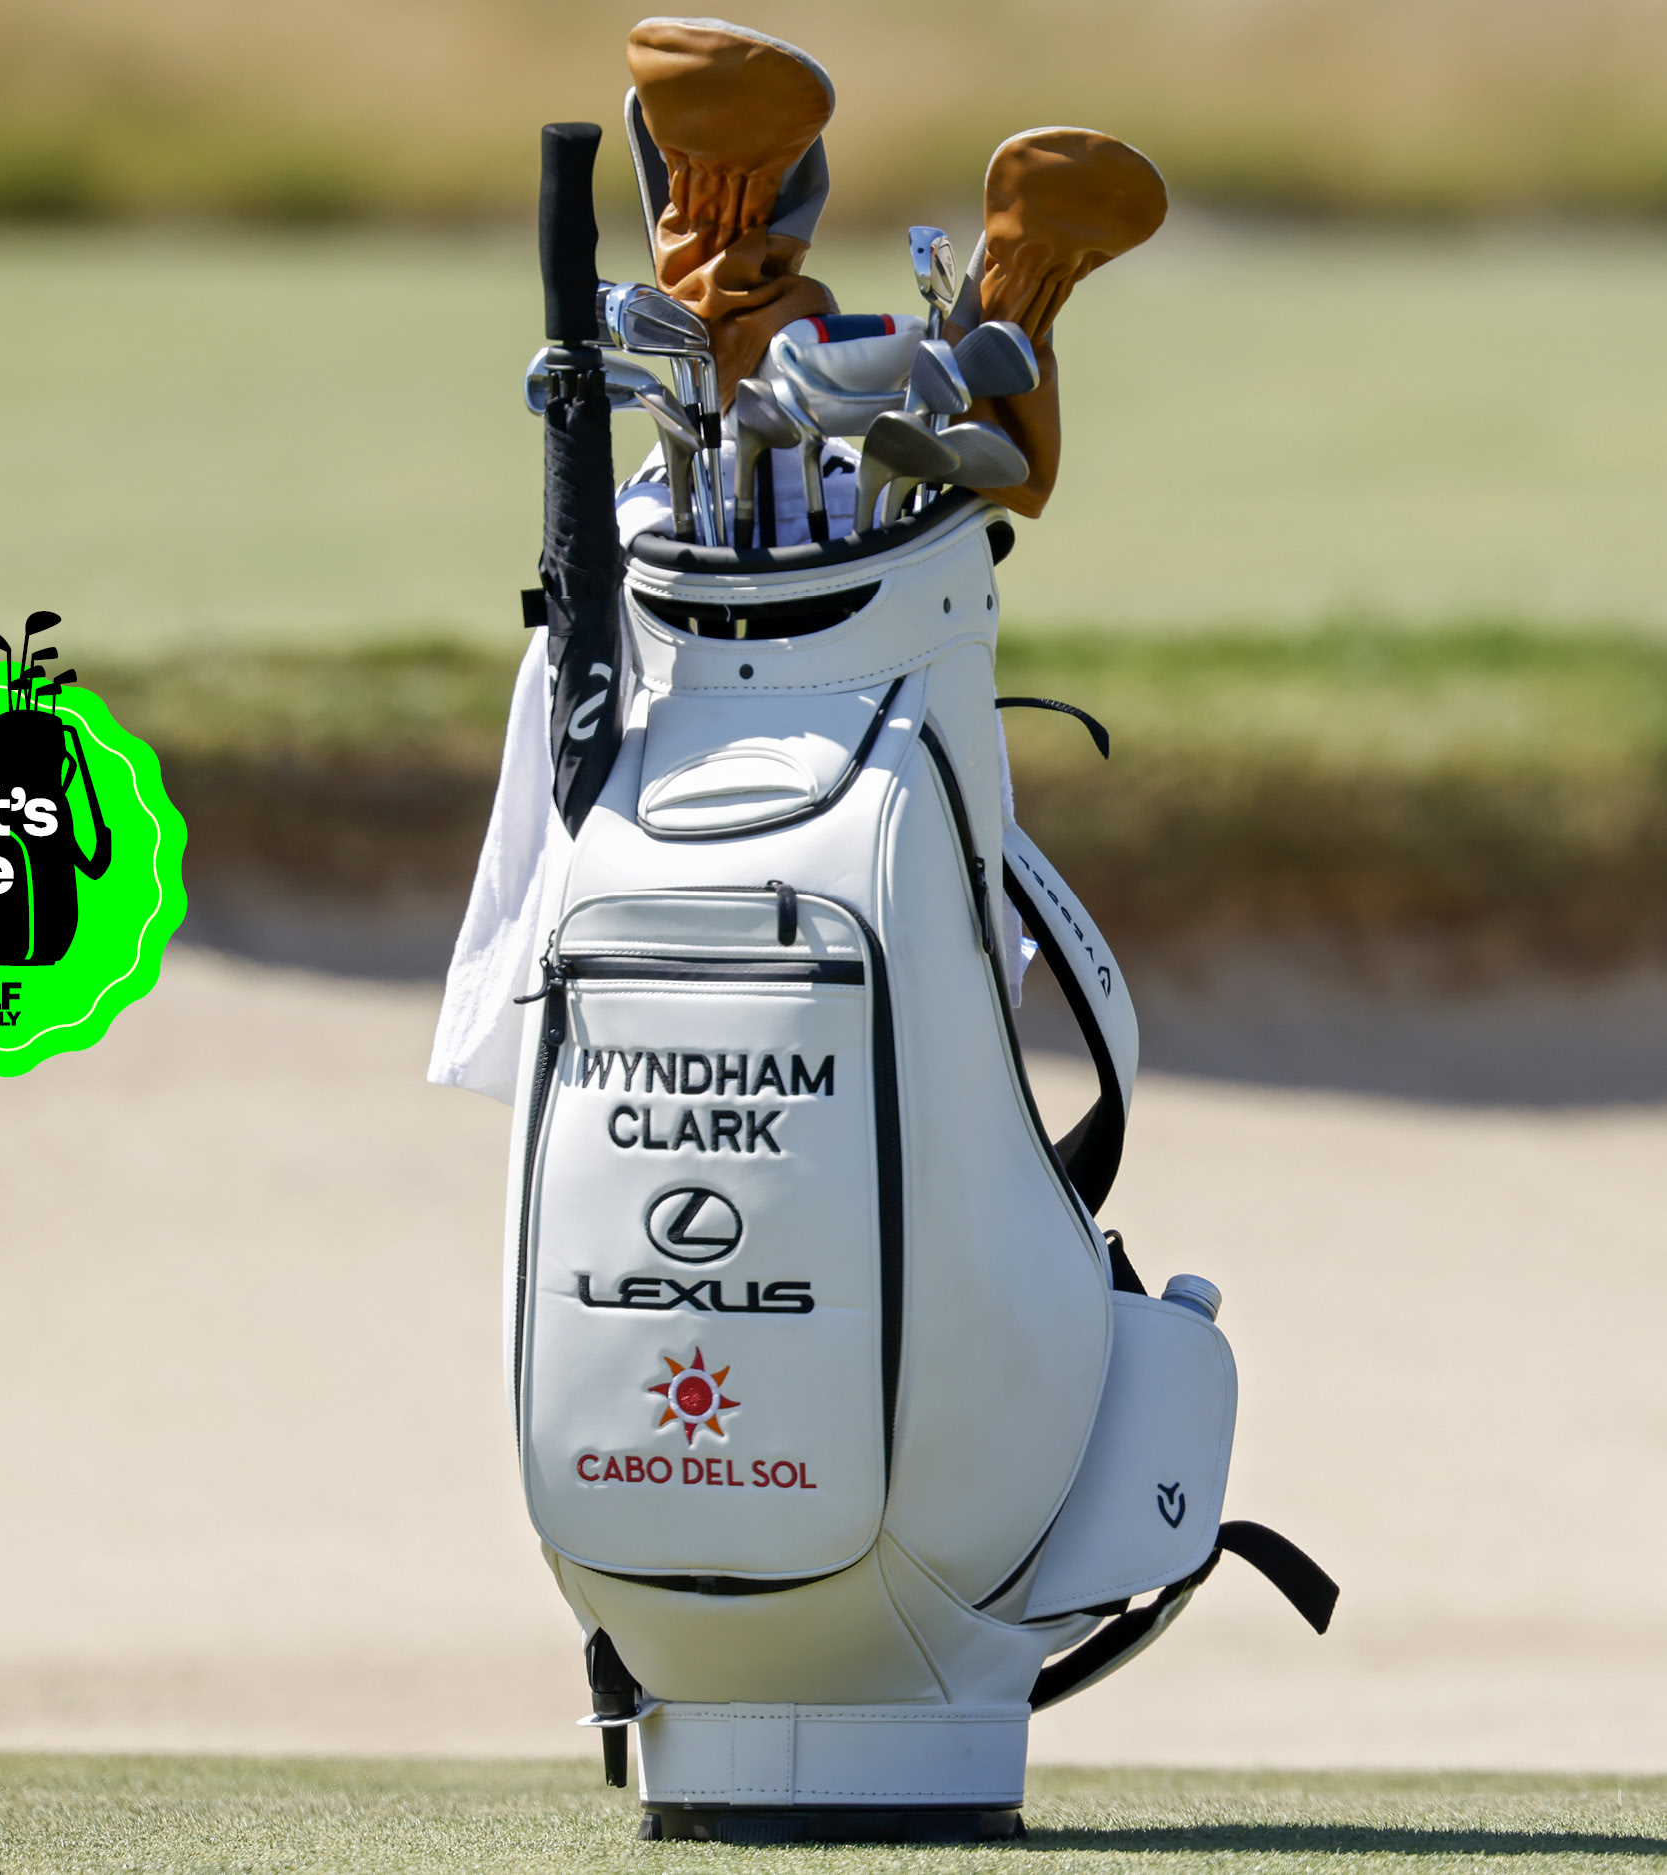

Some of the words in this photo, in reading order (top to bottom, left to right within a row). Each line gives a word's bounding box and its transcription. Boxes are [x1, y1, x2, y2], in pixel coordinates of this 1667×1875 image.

[581, 1049, 835, 1097] WYNDHAM
[608, 1104, 781, 1154] CLARK
[578, 1274, 815, 1314] LEXUS
[577, 1454, 673, 1485] CABO
[682, 1458, 744, 1487] DEL
[752, 1460, 817, 1489] SOL
